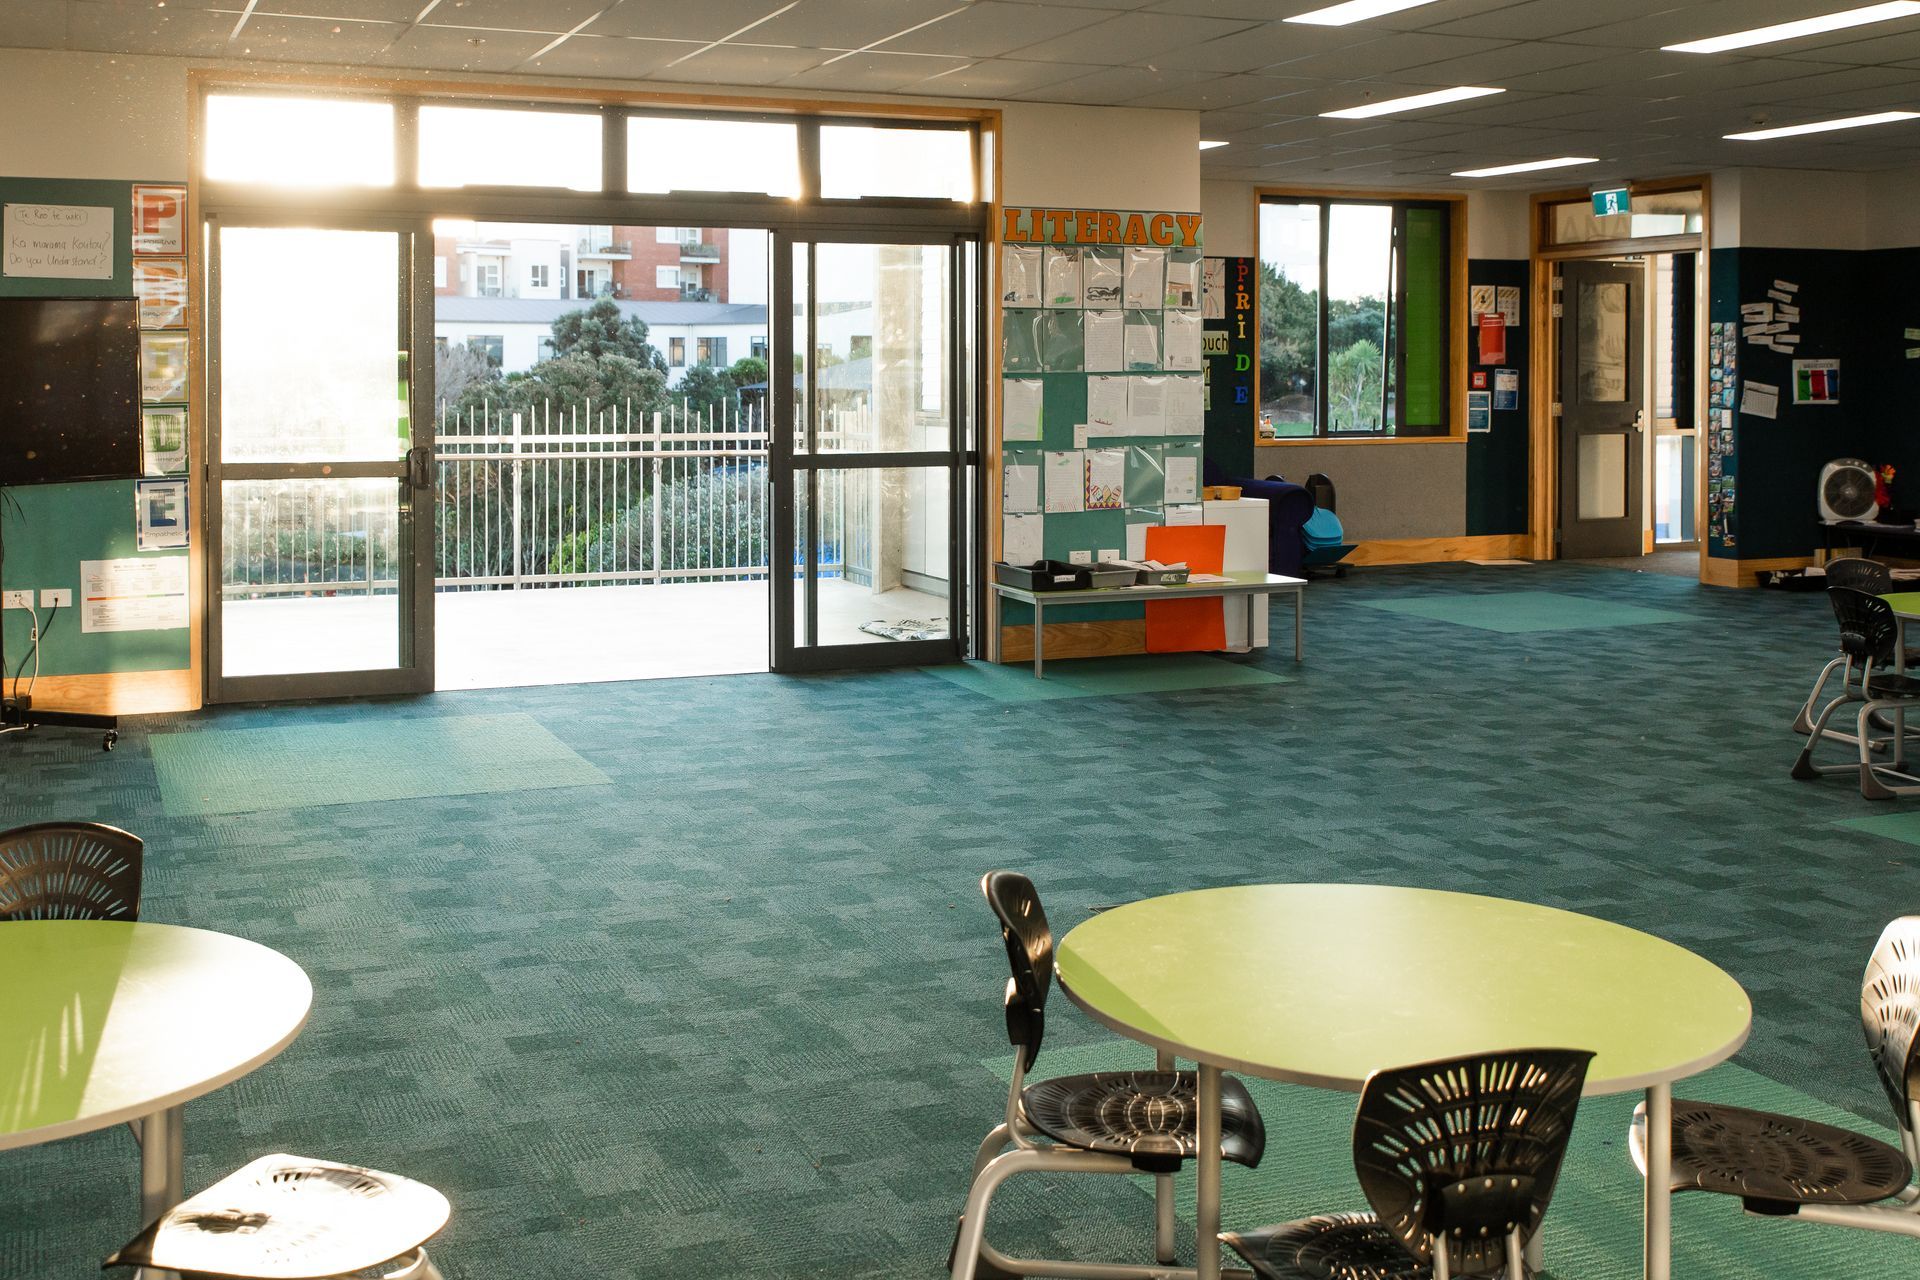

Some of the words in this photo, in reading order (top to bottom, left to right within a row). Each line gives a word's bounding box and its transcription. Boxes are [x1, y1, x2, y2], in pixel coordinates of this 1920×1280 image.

[143, 195, 177, 233] P
[1004, 208, 1203, 247] LITERACY
[12, 235, 26, 248] Ka
[10, 253, 22, 265] Do
[26, 257, 42, 268] you
[145, 530, 184, 540] Empathetic
